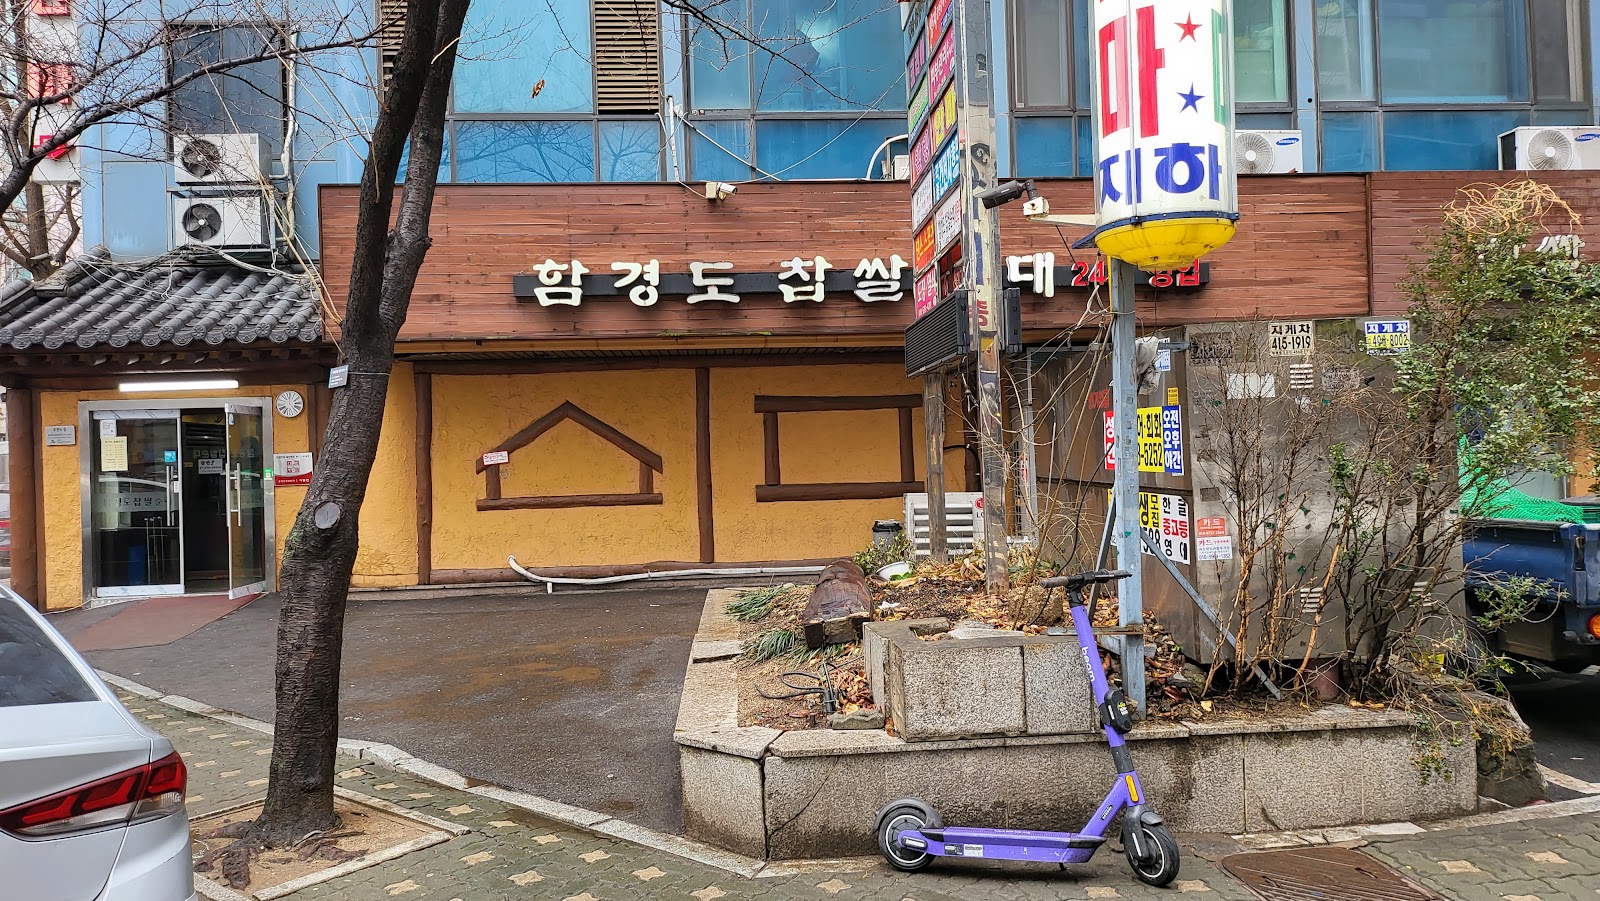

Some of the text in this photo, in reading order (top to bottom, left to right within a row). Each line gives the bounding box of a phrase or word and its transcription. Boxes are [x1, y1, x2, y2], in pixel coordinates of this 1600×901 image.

[1100, 143, 1223, 205] 지하
[532, 253, 1056, 308] 함경도 찹쌀대
[1367, 323, 1408, 333] 지게차
[1271, 336, 1311, 350] 415-1919
[1163, 410, 1179, 429] 오전
[1164, 430, 1180, 450] 오후
[1165, 450, 1182, 470] 야간
[1163, 517, 1188, 538] 중고등
[1203, 518, 1220, 526] 카드
[1082, 646, 1096, 682] beam
